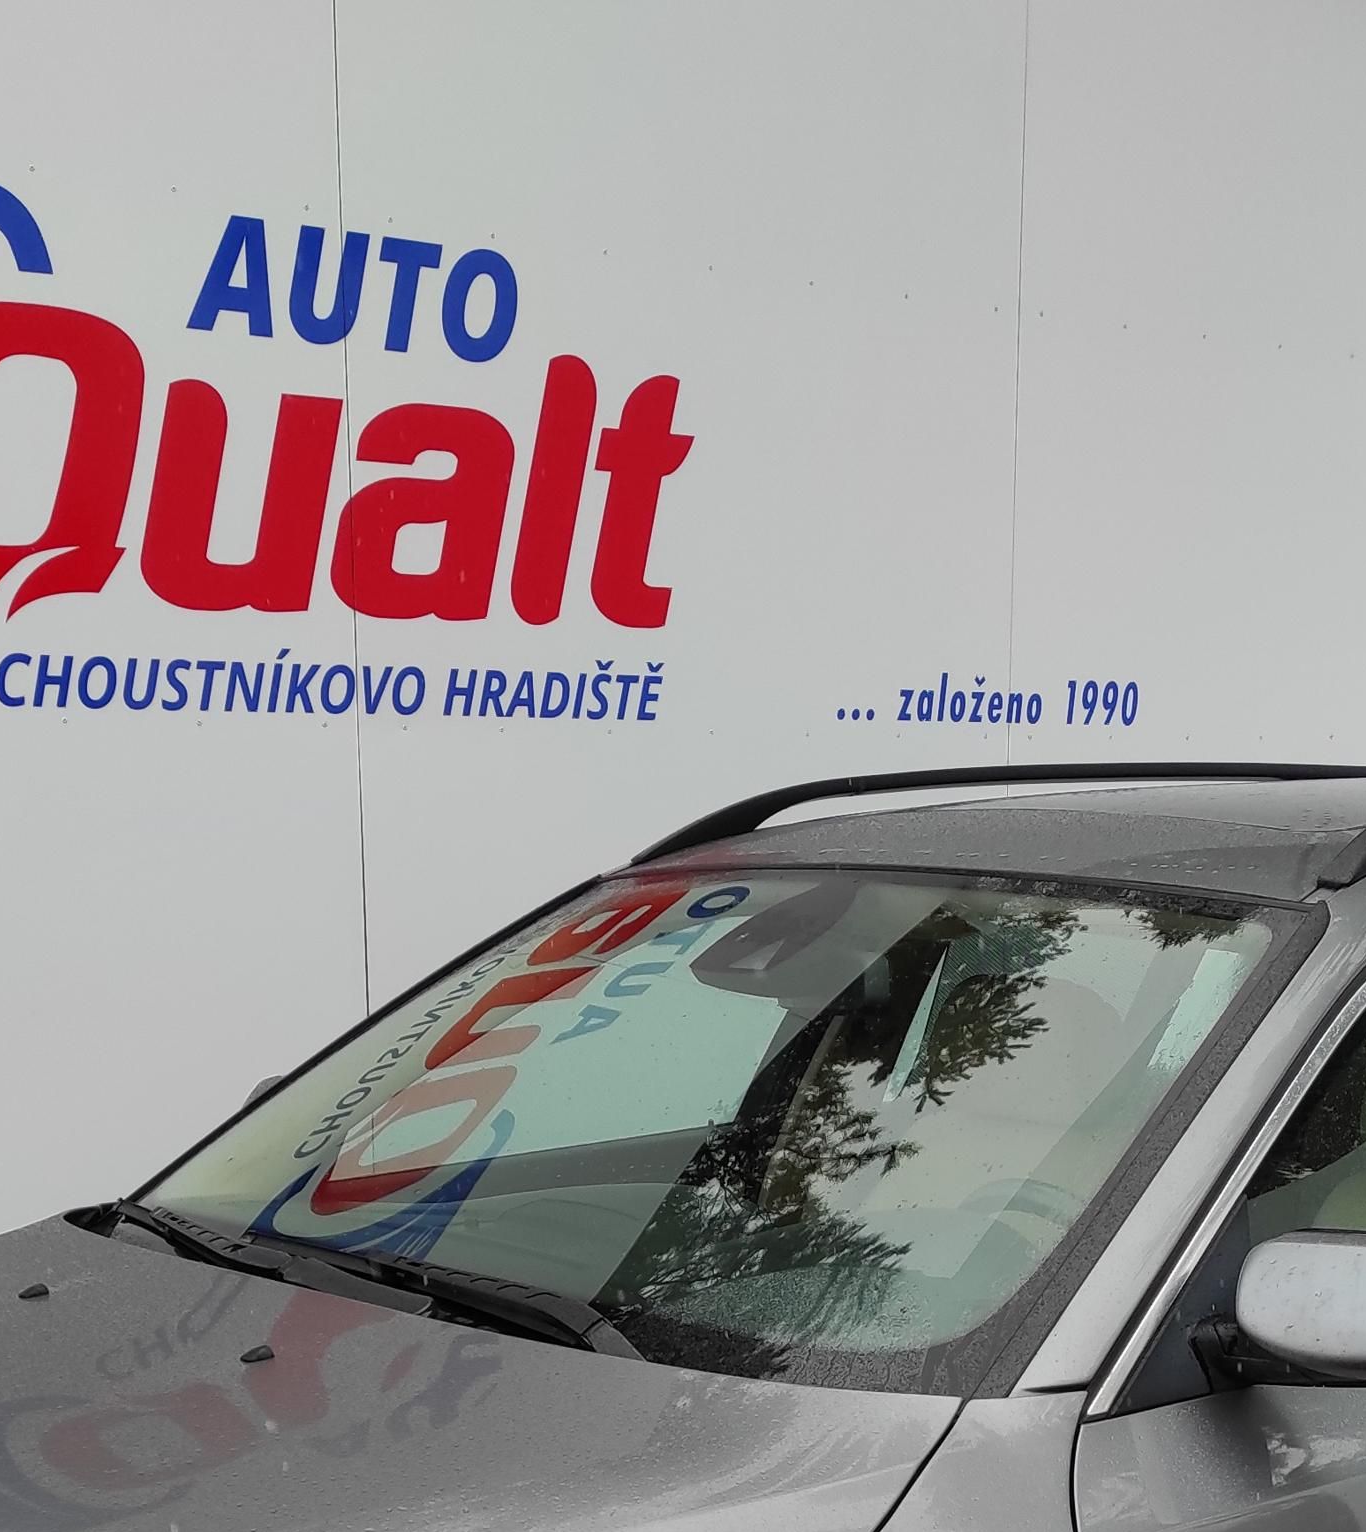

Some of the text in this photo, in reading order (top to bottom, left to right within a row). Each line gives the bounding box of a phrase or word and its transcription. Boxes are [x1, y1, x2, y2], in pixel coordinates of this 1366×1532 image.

[187, 214, 519, 365] AUTO
[443, 660, 664, 721] HRADIŠTĚ
[897, 671, 1043, 725] založeno
[1066, 680, 1139, 727] 1990
